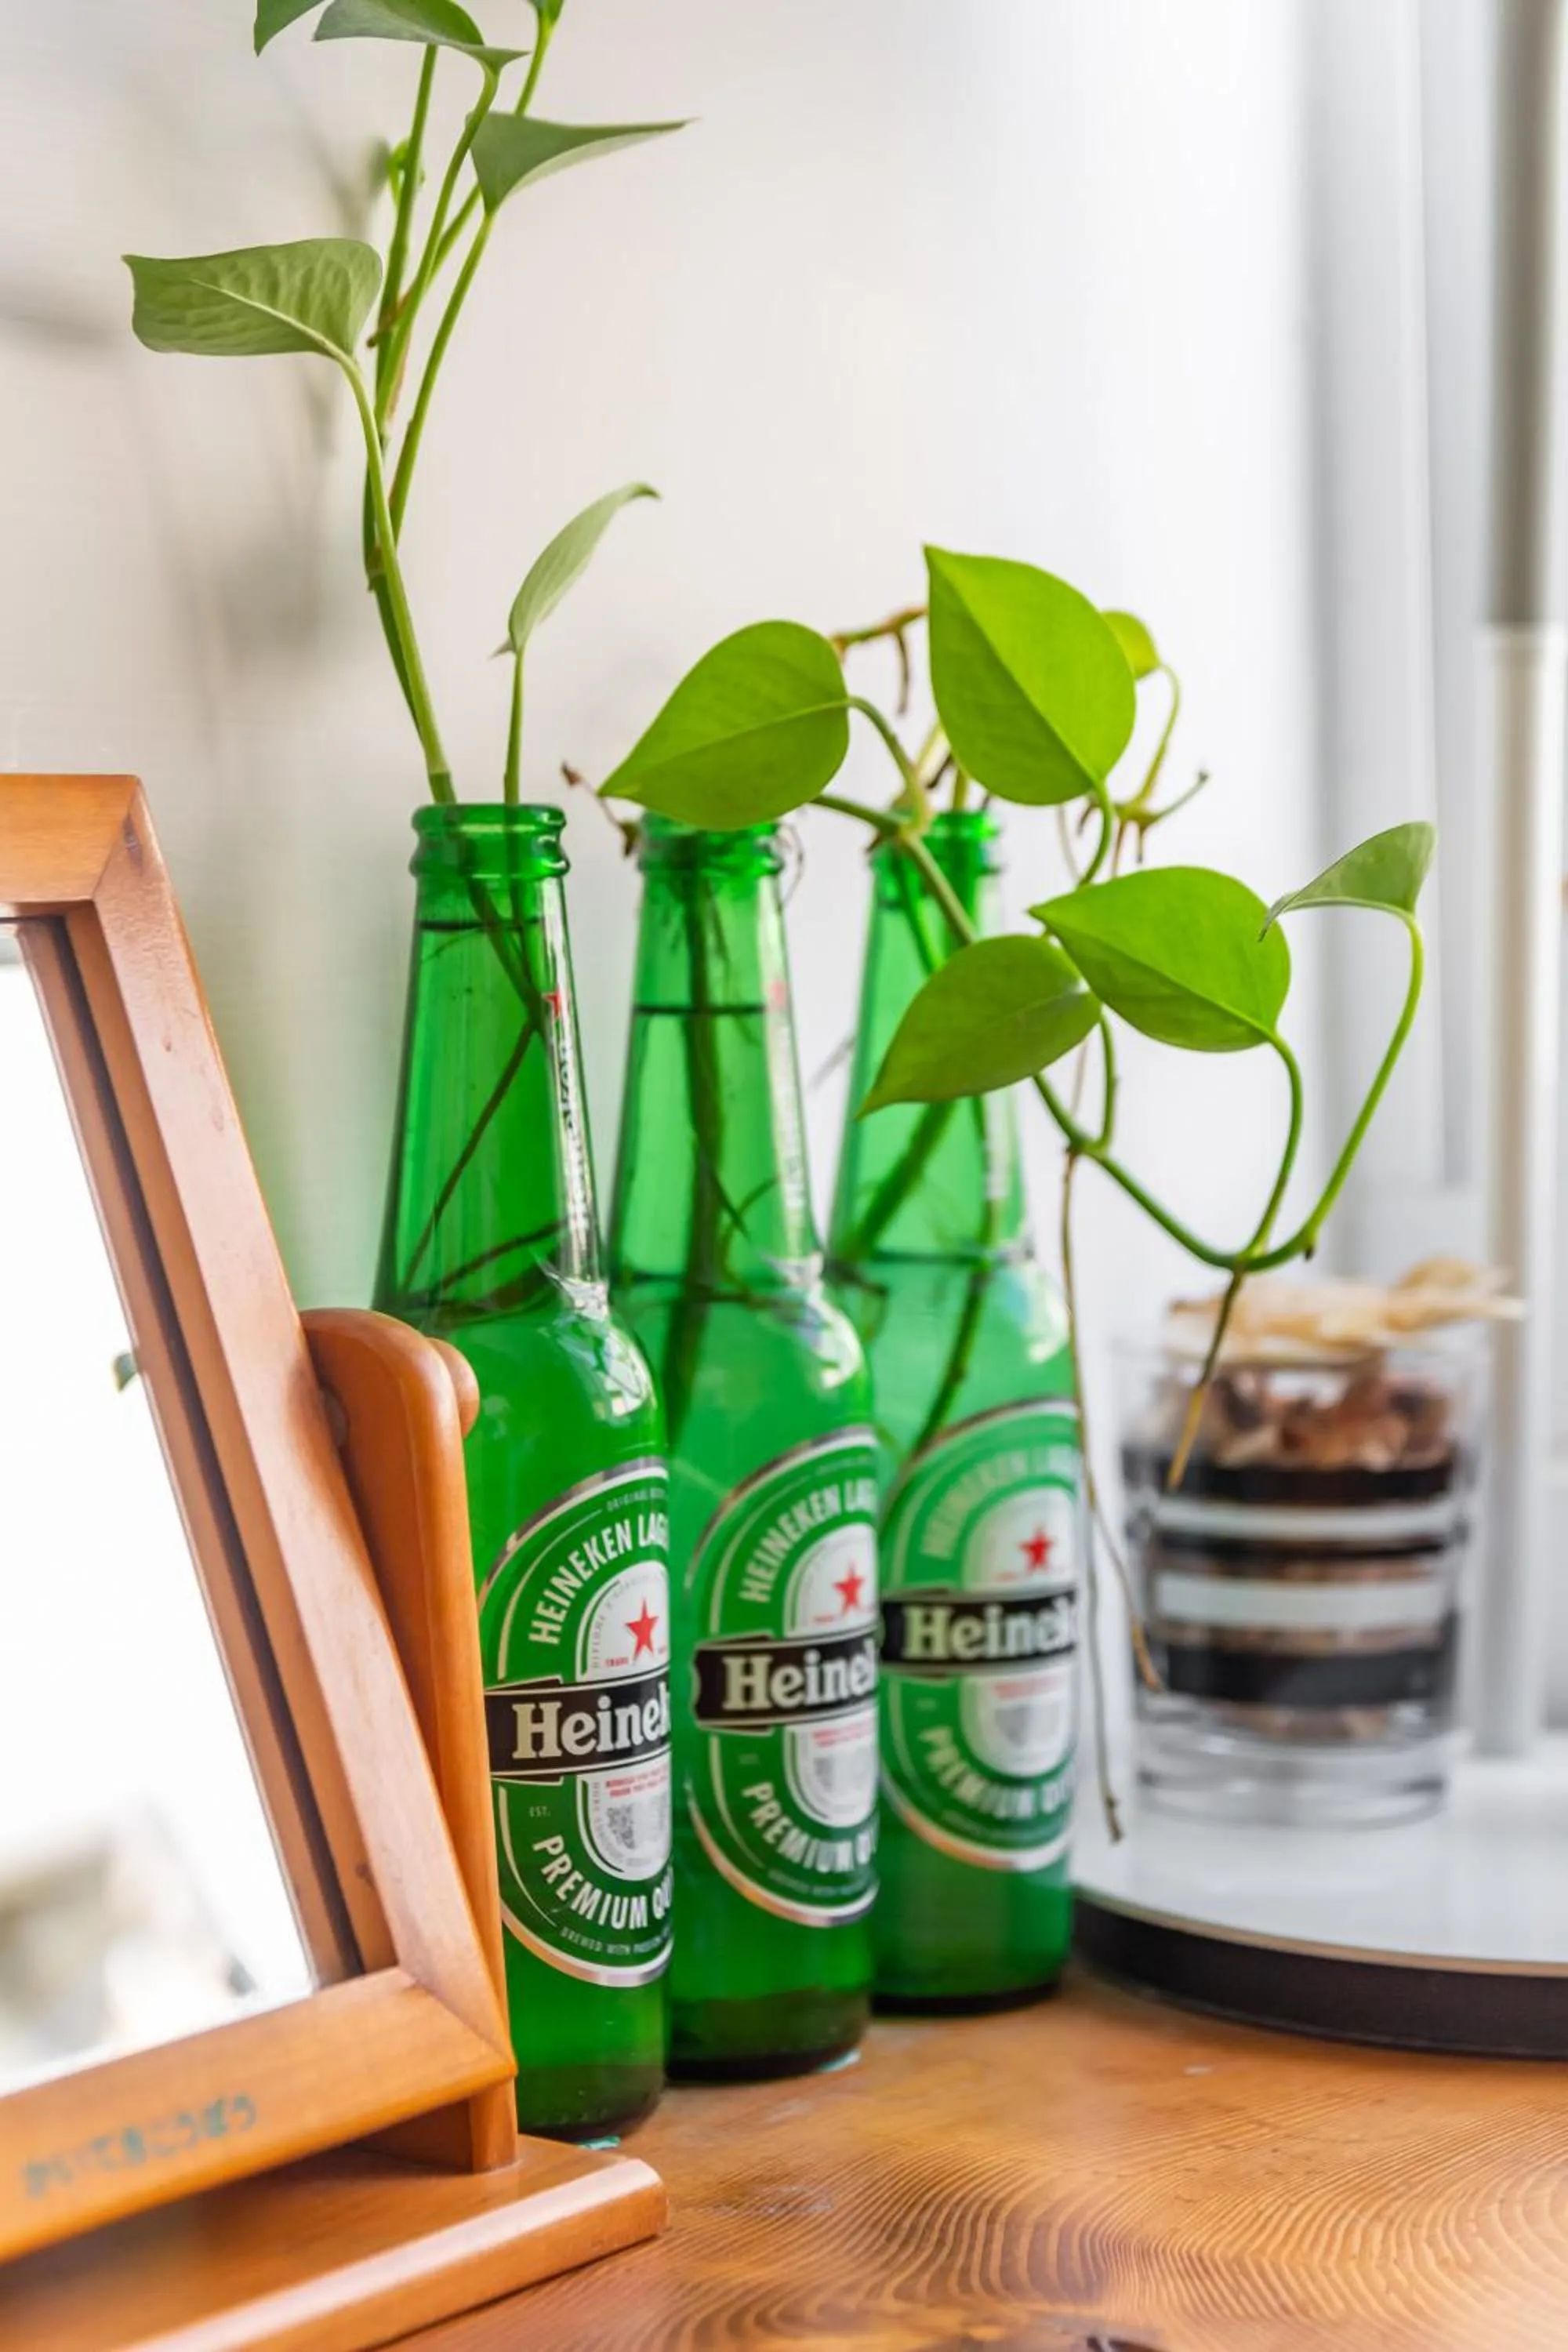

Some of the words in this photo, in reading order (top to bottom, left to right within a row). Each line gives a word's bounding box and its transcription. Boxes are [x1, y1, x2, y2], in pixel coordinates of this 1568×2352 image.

[528, 1518, 633, 1645] HEINEKEN
[738, 1483, 842, 1602] HEINEKEN
[740, 1781, 855, 1873] PREMIUM
[532, 1834, 648, 1930] PREMIUM
